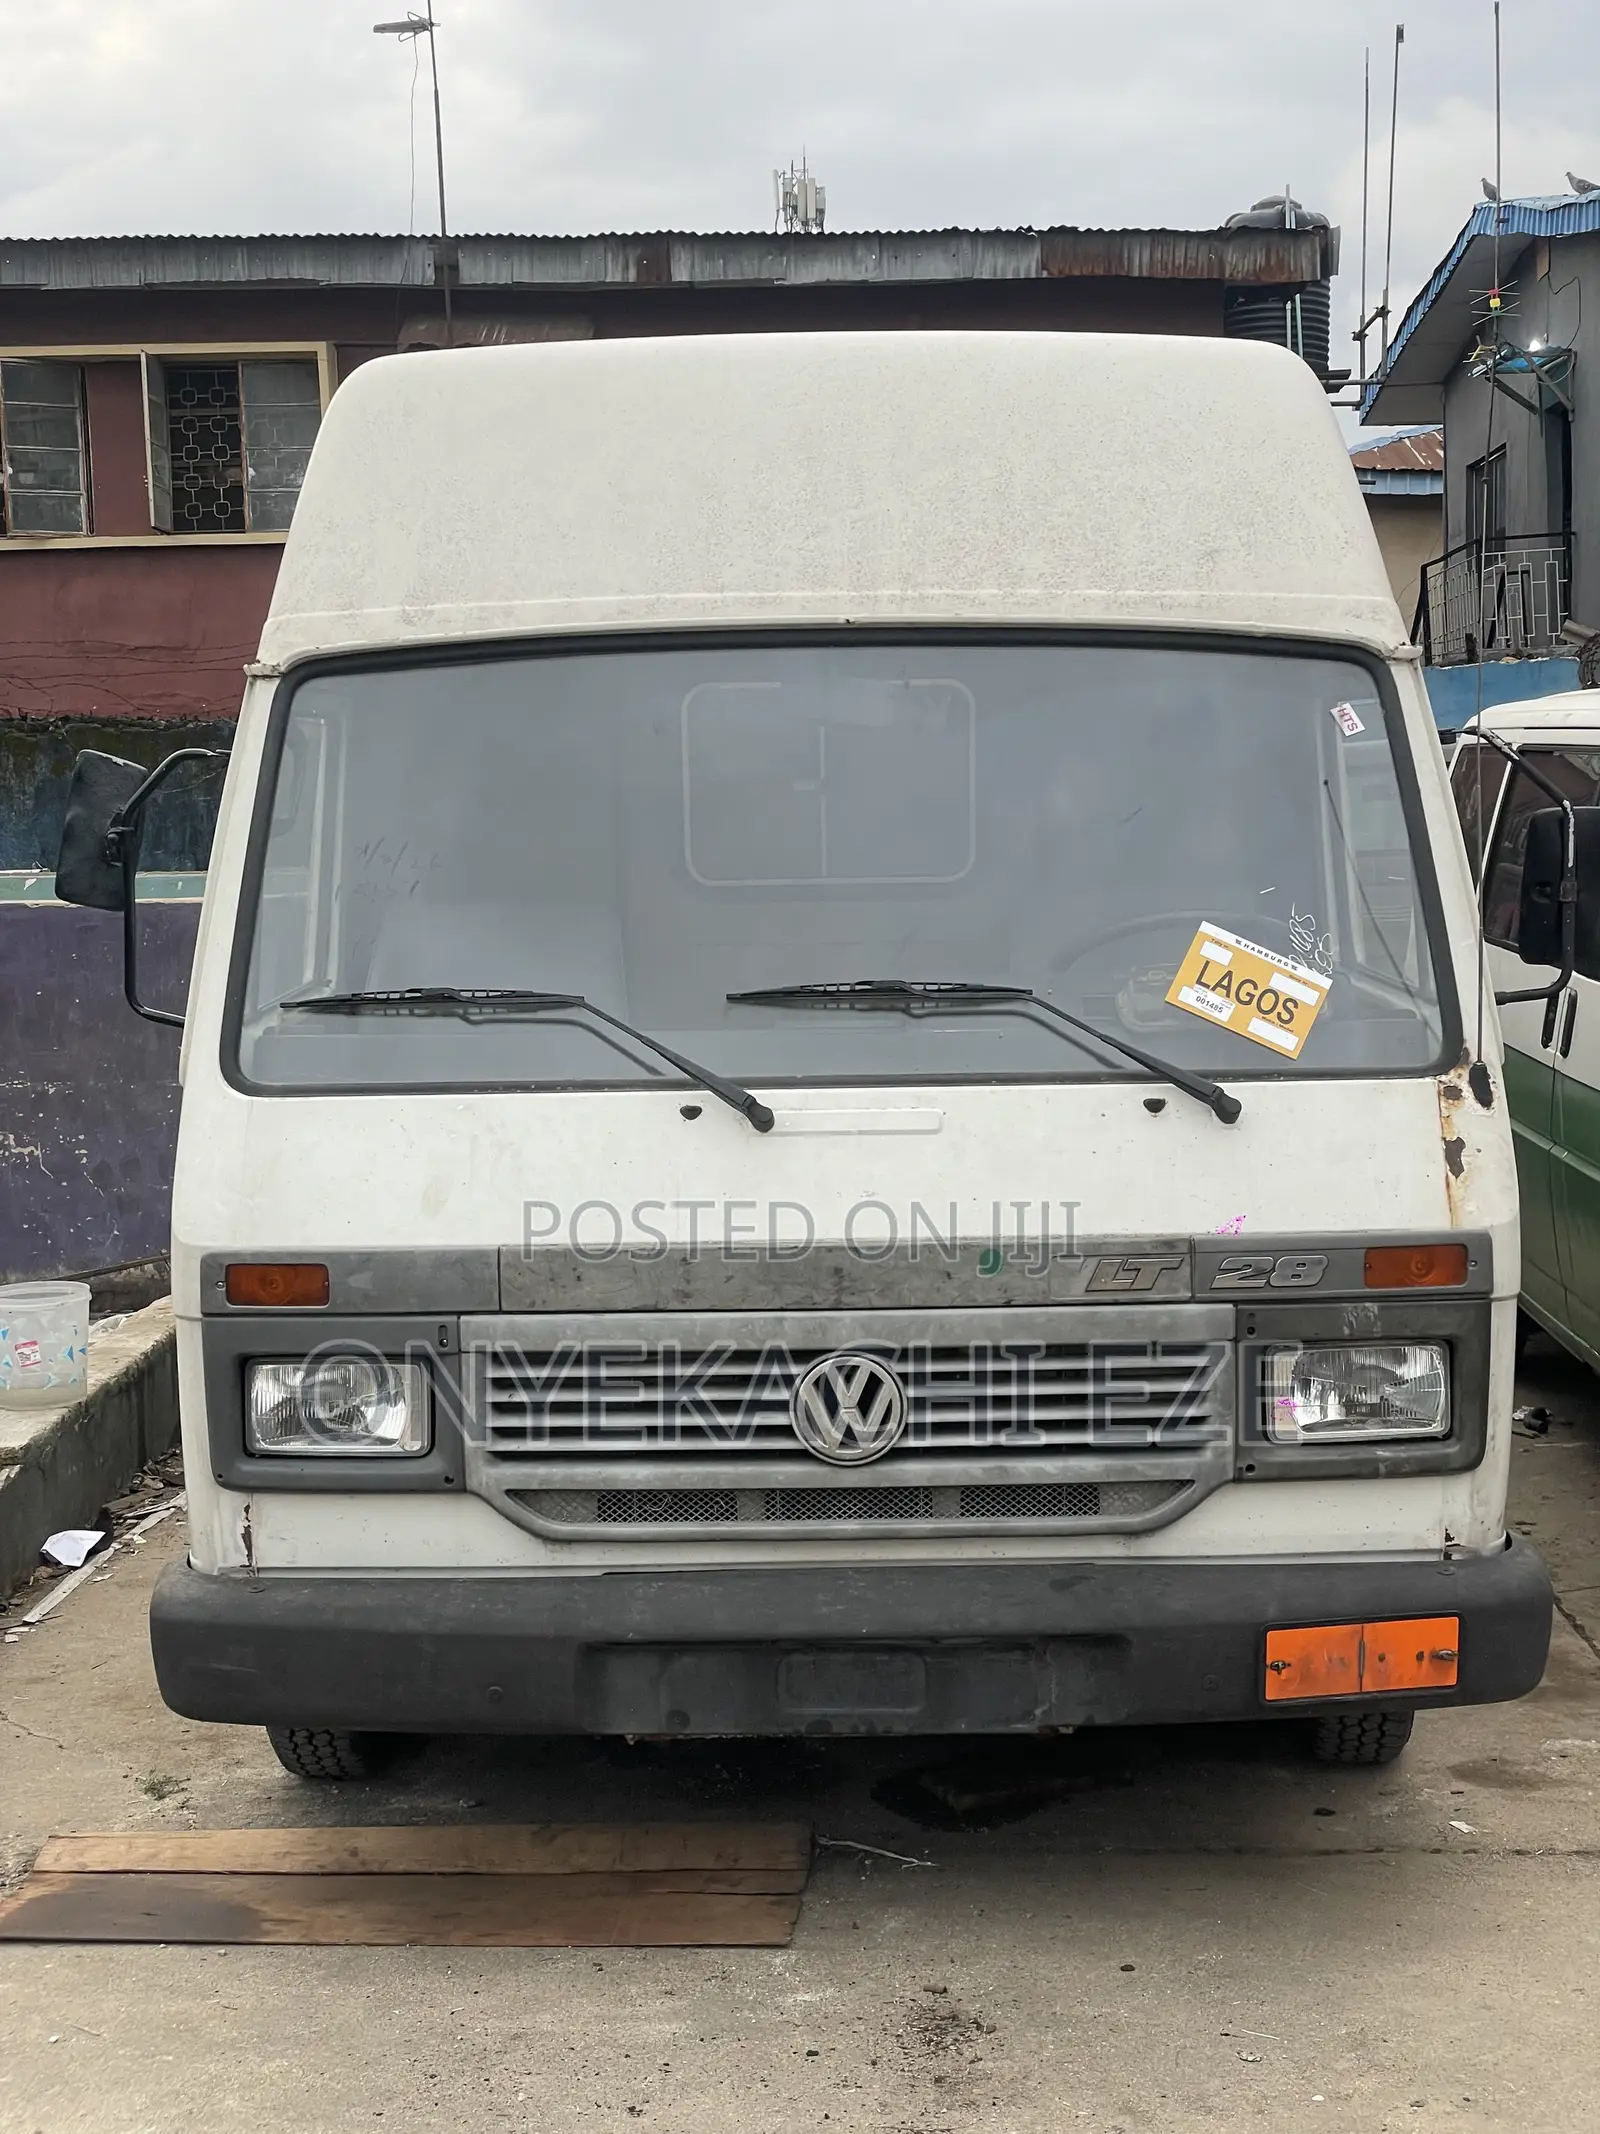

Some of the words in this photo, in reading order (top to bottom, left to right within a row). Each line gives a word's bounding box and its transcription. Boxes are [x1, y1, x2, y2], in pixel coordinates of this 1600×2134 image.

[1337, 707, 1358, 732] HTS
[1243, 943, 1289, 967] HAMBURG
[1194, 960, 1299, 1025] LAGOS
[1195, 995, 1224, 1013] 001485
[1085, 1257, 1184, 1292] LT
[1208, 1254, 1329, 1290] 28
